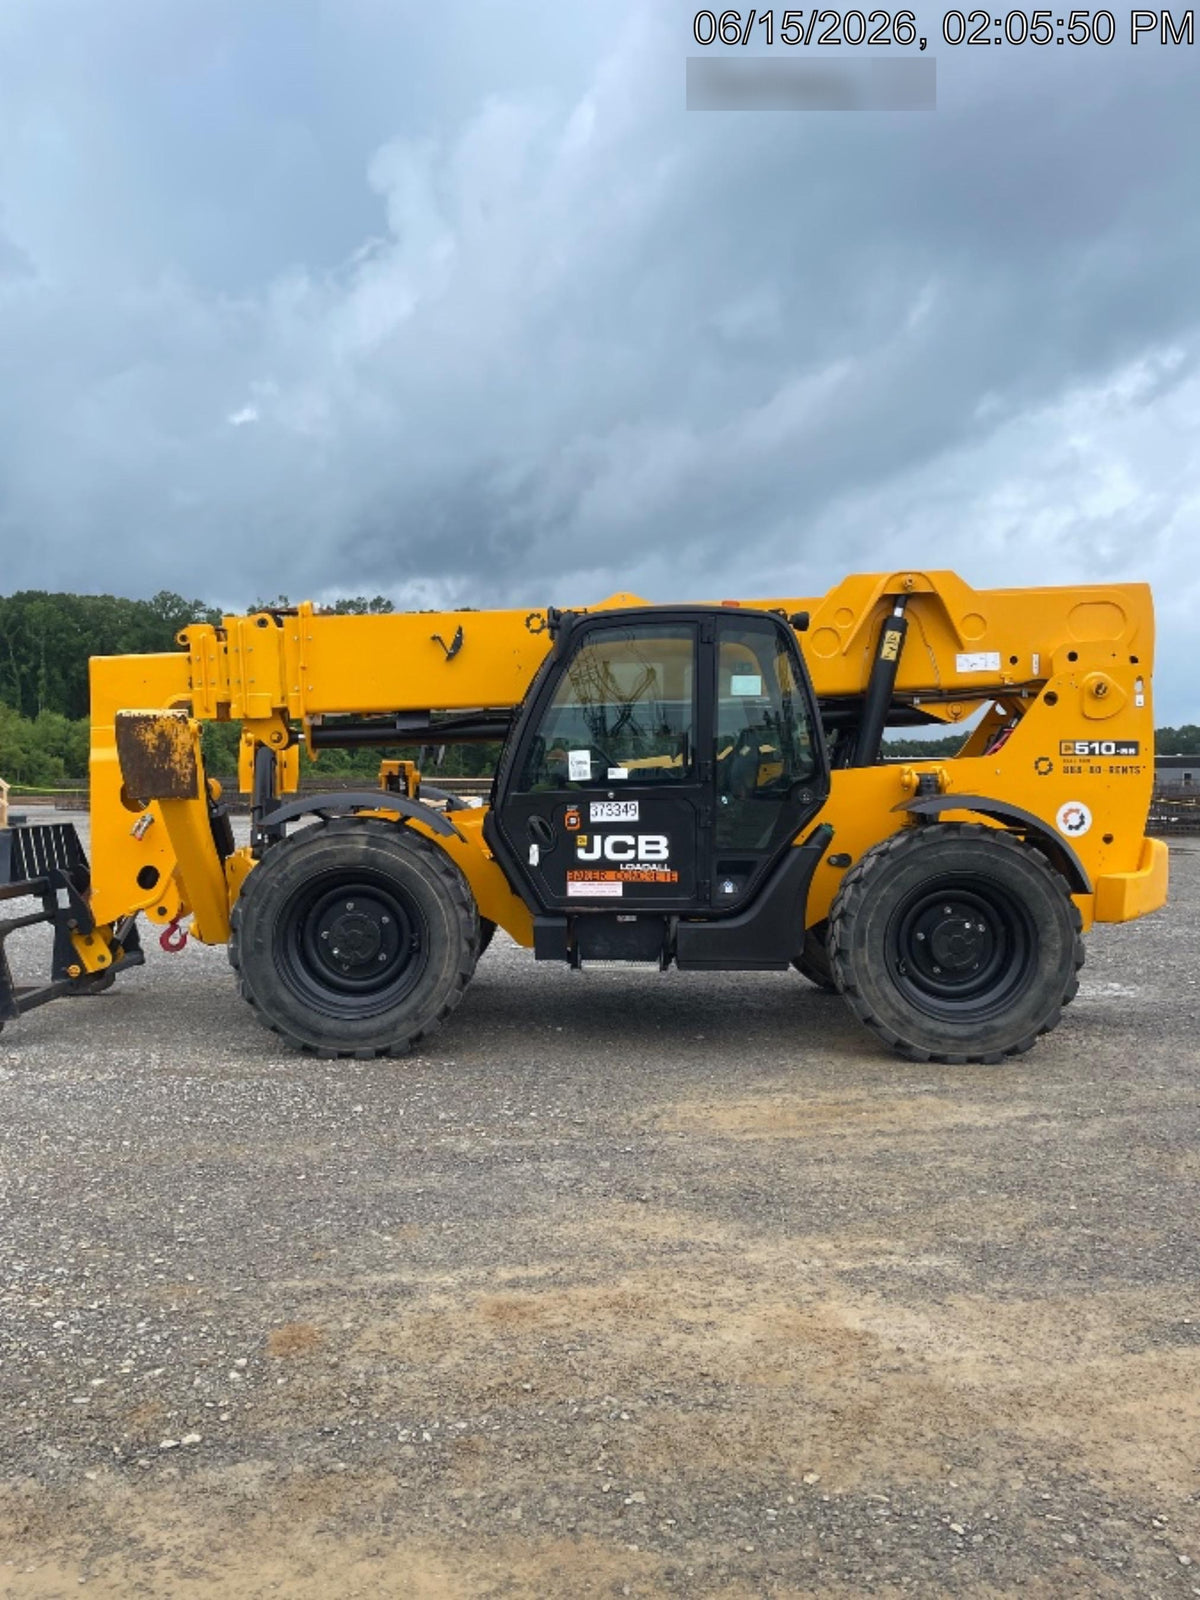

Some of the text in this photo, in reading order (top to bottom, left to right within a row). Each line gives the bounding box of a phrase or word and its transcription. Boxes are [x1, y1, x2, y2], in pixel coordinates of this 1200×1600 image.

[591, 803, 638, 818] 373349
[577, 835, 669, 860] JCB
[620, 863, 671, 871] LOADALL
[615, 871, 678, 881] CONCRETE
